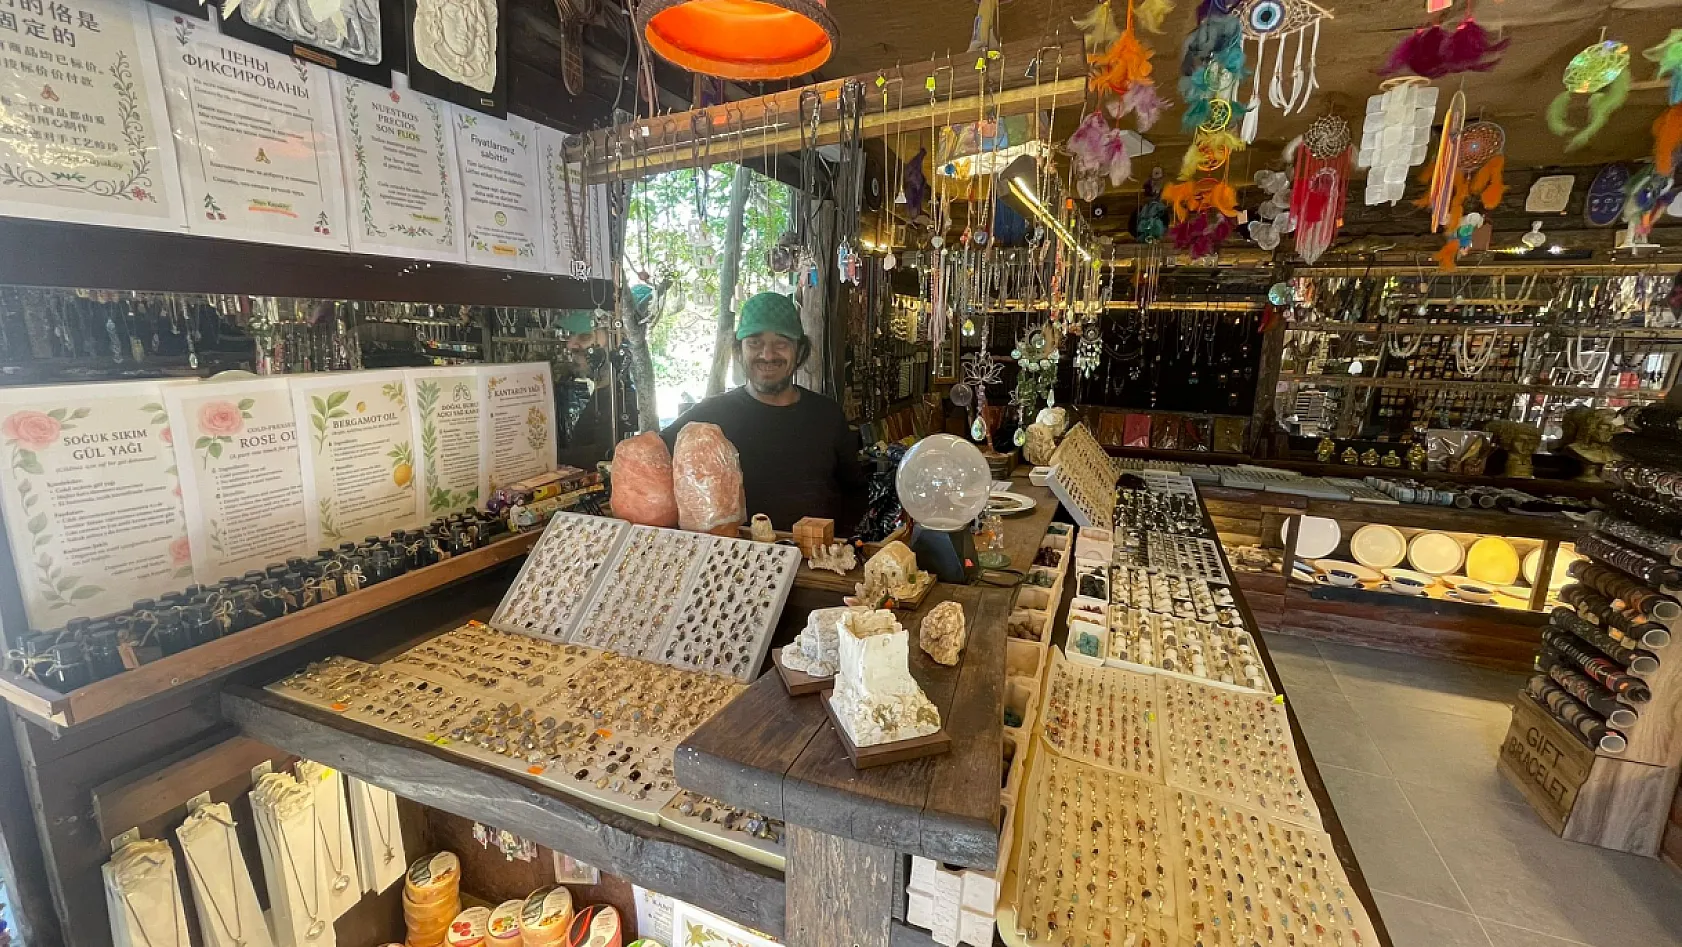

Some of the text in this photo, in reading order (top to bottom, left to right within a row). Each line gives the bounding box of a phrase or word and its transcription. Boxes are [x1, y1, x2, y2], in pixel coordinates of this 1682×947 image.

[220, 47, 270, 74] ЦЕНЫ
[182, 53, 310, 99] ФИКСИРОВАНЫ
[371, 101, 420, 122] NUESTROS
[375, 123, 395, 135] SON
[378, 113, 417, 132] PRECIOS
[332, 412, 399, 429] BERGAMOT OIL
[63, 428, 148, 447] SOĞUK SIKIM
[240, 433, 277, 449] ROSE
[72, 441, 143, 461] GÜL YAĞI
[1526, 726, 1565, 769] GIFT
[1508, 735, 1569, 807] BRACELET
